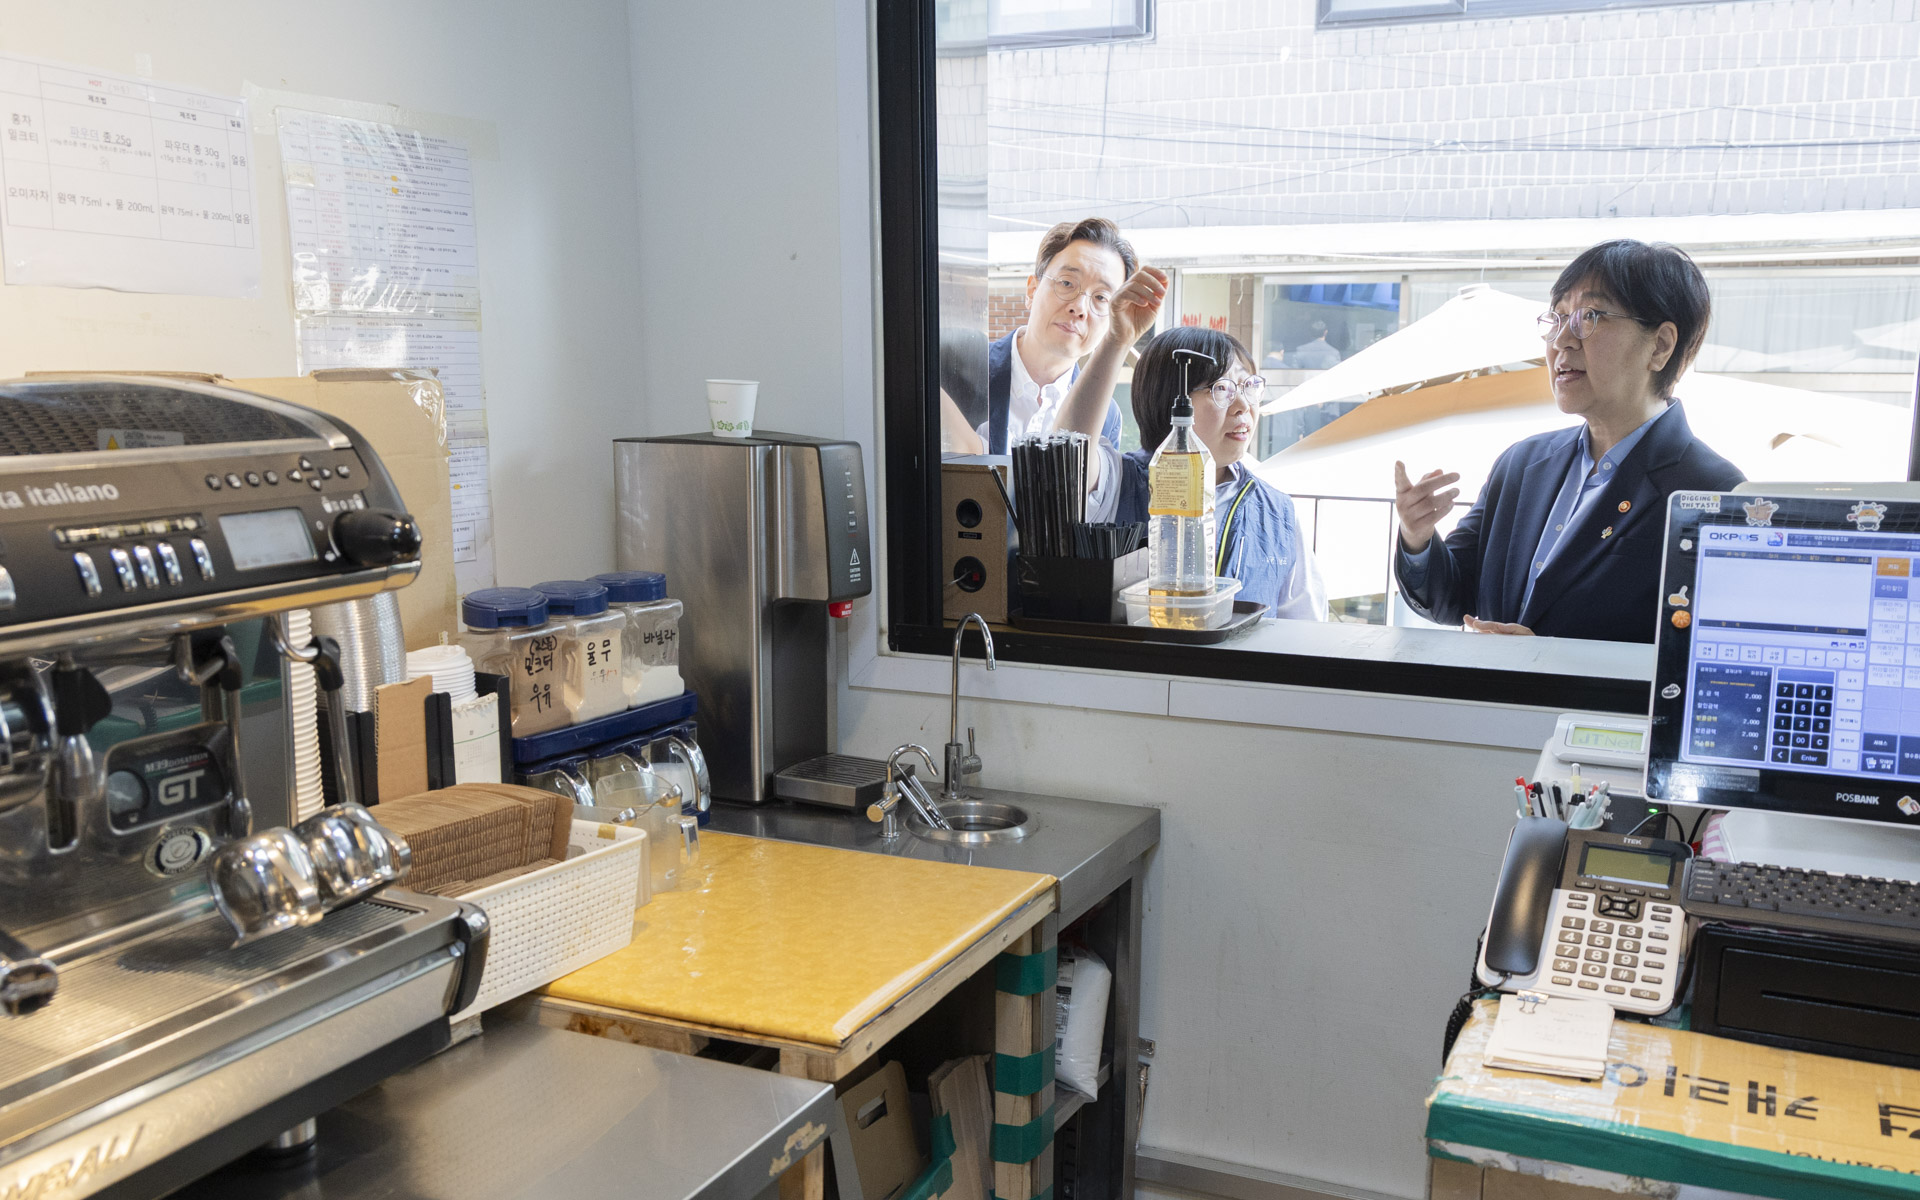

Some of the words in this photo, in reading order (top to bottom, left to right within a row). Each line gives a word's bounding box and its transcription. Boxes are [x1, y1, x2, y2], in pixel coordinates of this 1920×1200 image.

[11, 112, 32, 127] 홍차
[8, 128, 39, 144] 밀크티
[70, 126, 99, 141] 파우더
[115, 134, 132, 147] 25g
[164, 139, 191, 154] 파우더
[204, 146, 220, 160] 30g
[8, 186, 49, 202] 오미자차
[57, 192, 77, 205] 원액
[115, 199, 124, 210] 물
[127, 201, 155, 214] 200mL
[160, 205, 175, 216] 원액
[25, 482, 119, 507] italiano
[1681, 494, 1712, 502] DIGGING
[1709, 532, 1759, 542] OKPOS
[643, 629, 676, 646] 바닐라
[587, 639, 611, 666] 율무
[1782, 686, 1788, 694] 7
[1821, 689, 1827, 697] 9
[530, 683, 552, 713] 우유
[1781, 702, 1787, 710] 4
[1819, 705, 1825, 713] 6
[1799, 720, 1805, 728] 2
[1578, 733, 1637, 749] JTNet
[1778, 735, 1784, 743] 0
[1816, 738, 1823, 746] C
[1801, 754, 1818, 762] Enter
[158, 769, 205, 806] GT
[1835, 792, 1880, 805] POSBANK
[1569, 918, 1576, 927] 1
[1597, 922, 1607, 931] 2
[1626, 926, 1636, 935] 3
[1565, 932, 1575, 941] 4
[1594, 936, 1604, 945] 5
[1623, 941, 1633, 950] 6
[1563, 946, 1573, 955] 7
[1591, 950, 1602, 959] 8
[1621, 955, 1631, 964] 9
[1588, 965, 1600, 974] 0
